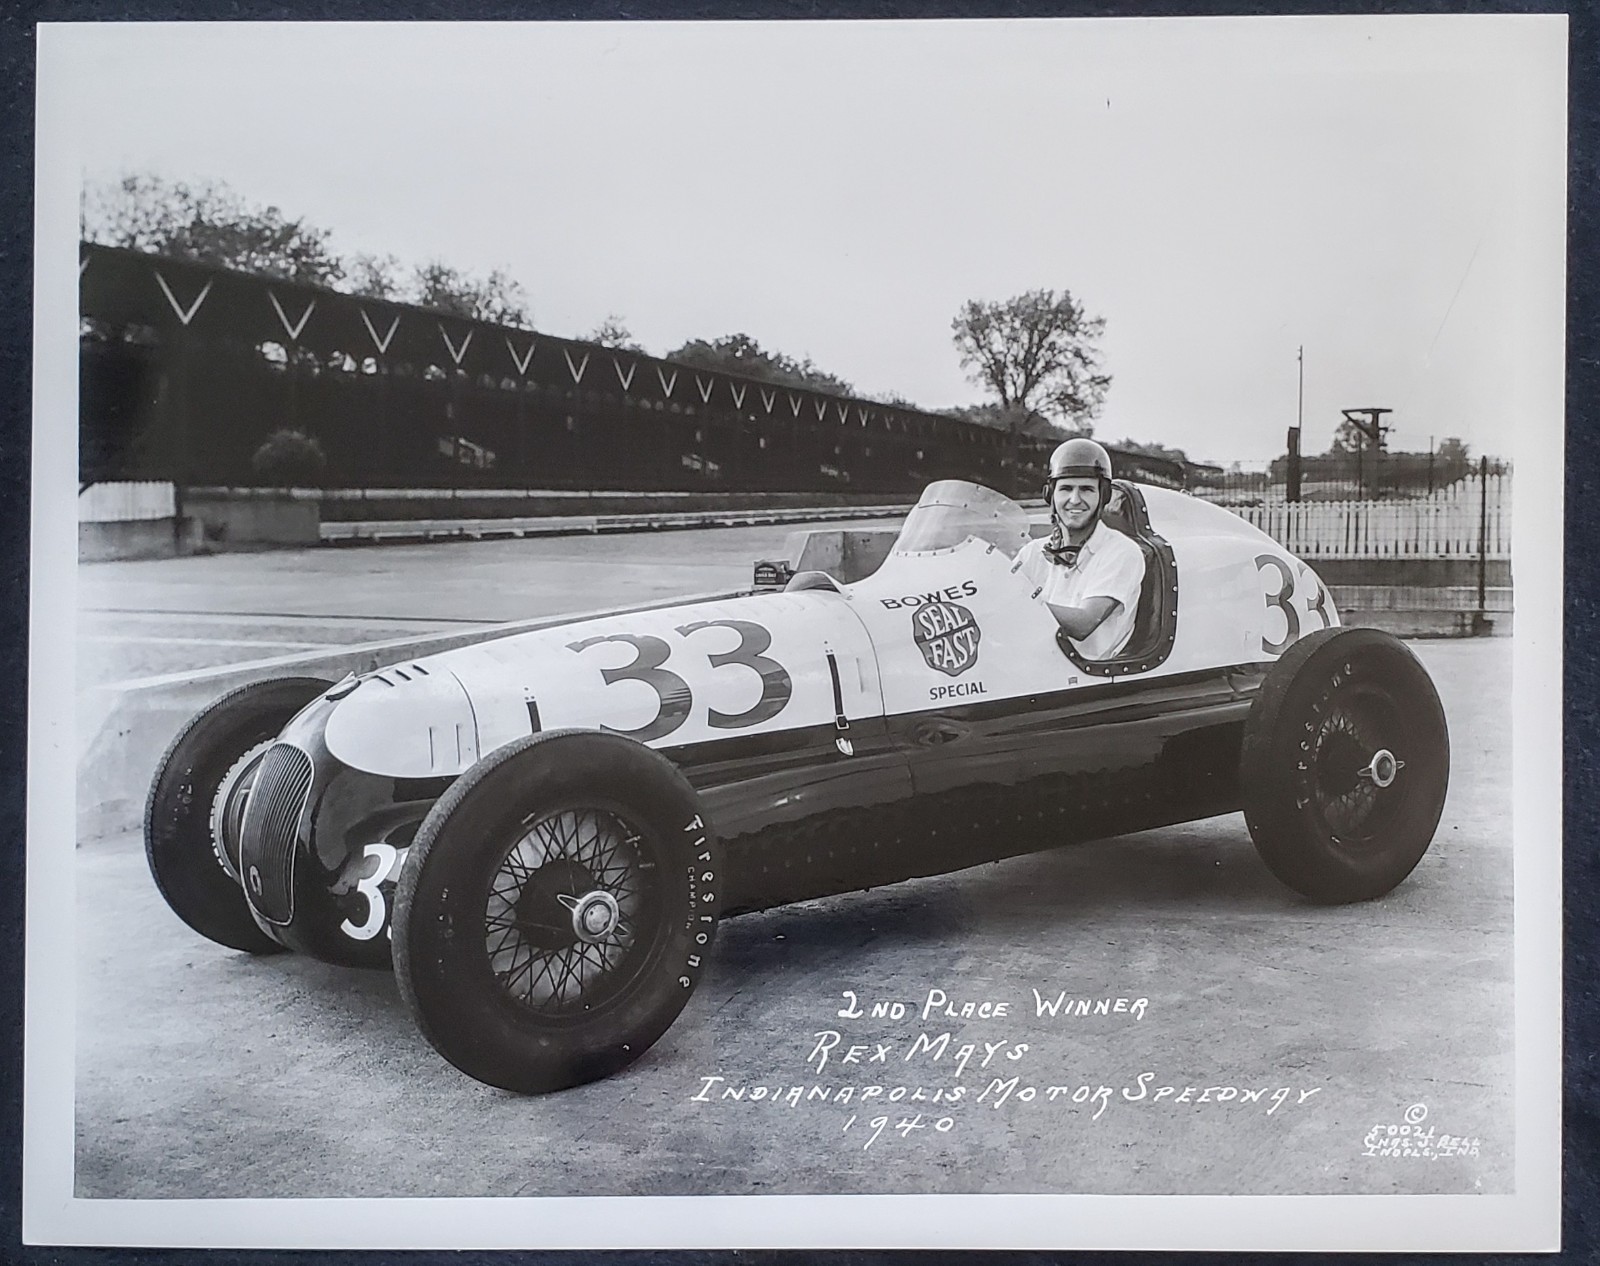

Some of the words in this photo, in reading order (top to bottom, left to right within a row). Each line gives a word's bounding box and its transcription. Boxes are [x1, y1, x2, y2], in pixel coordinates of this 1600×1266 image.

[880, 580, 977, 609] BOWES
[918, 603, 968, 640] SEAL
[929, 627, 975, 669] FAST
[565, 620, 793, 743] 33
[929, 681, 987, 700] SPECIAL
[340, 843, 404, 941] 3
